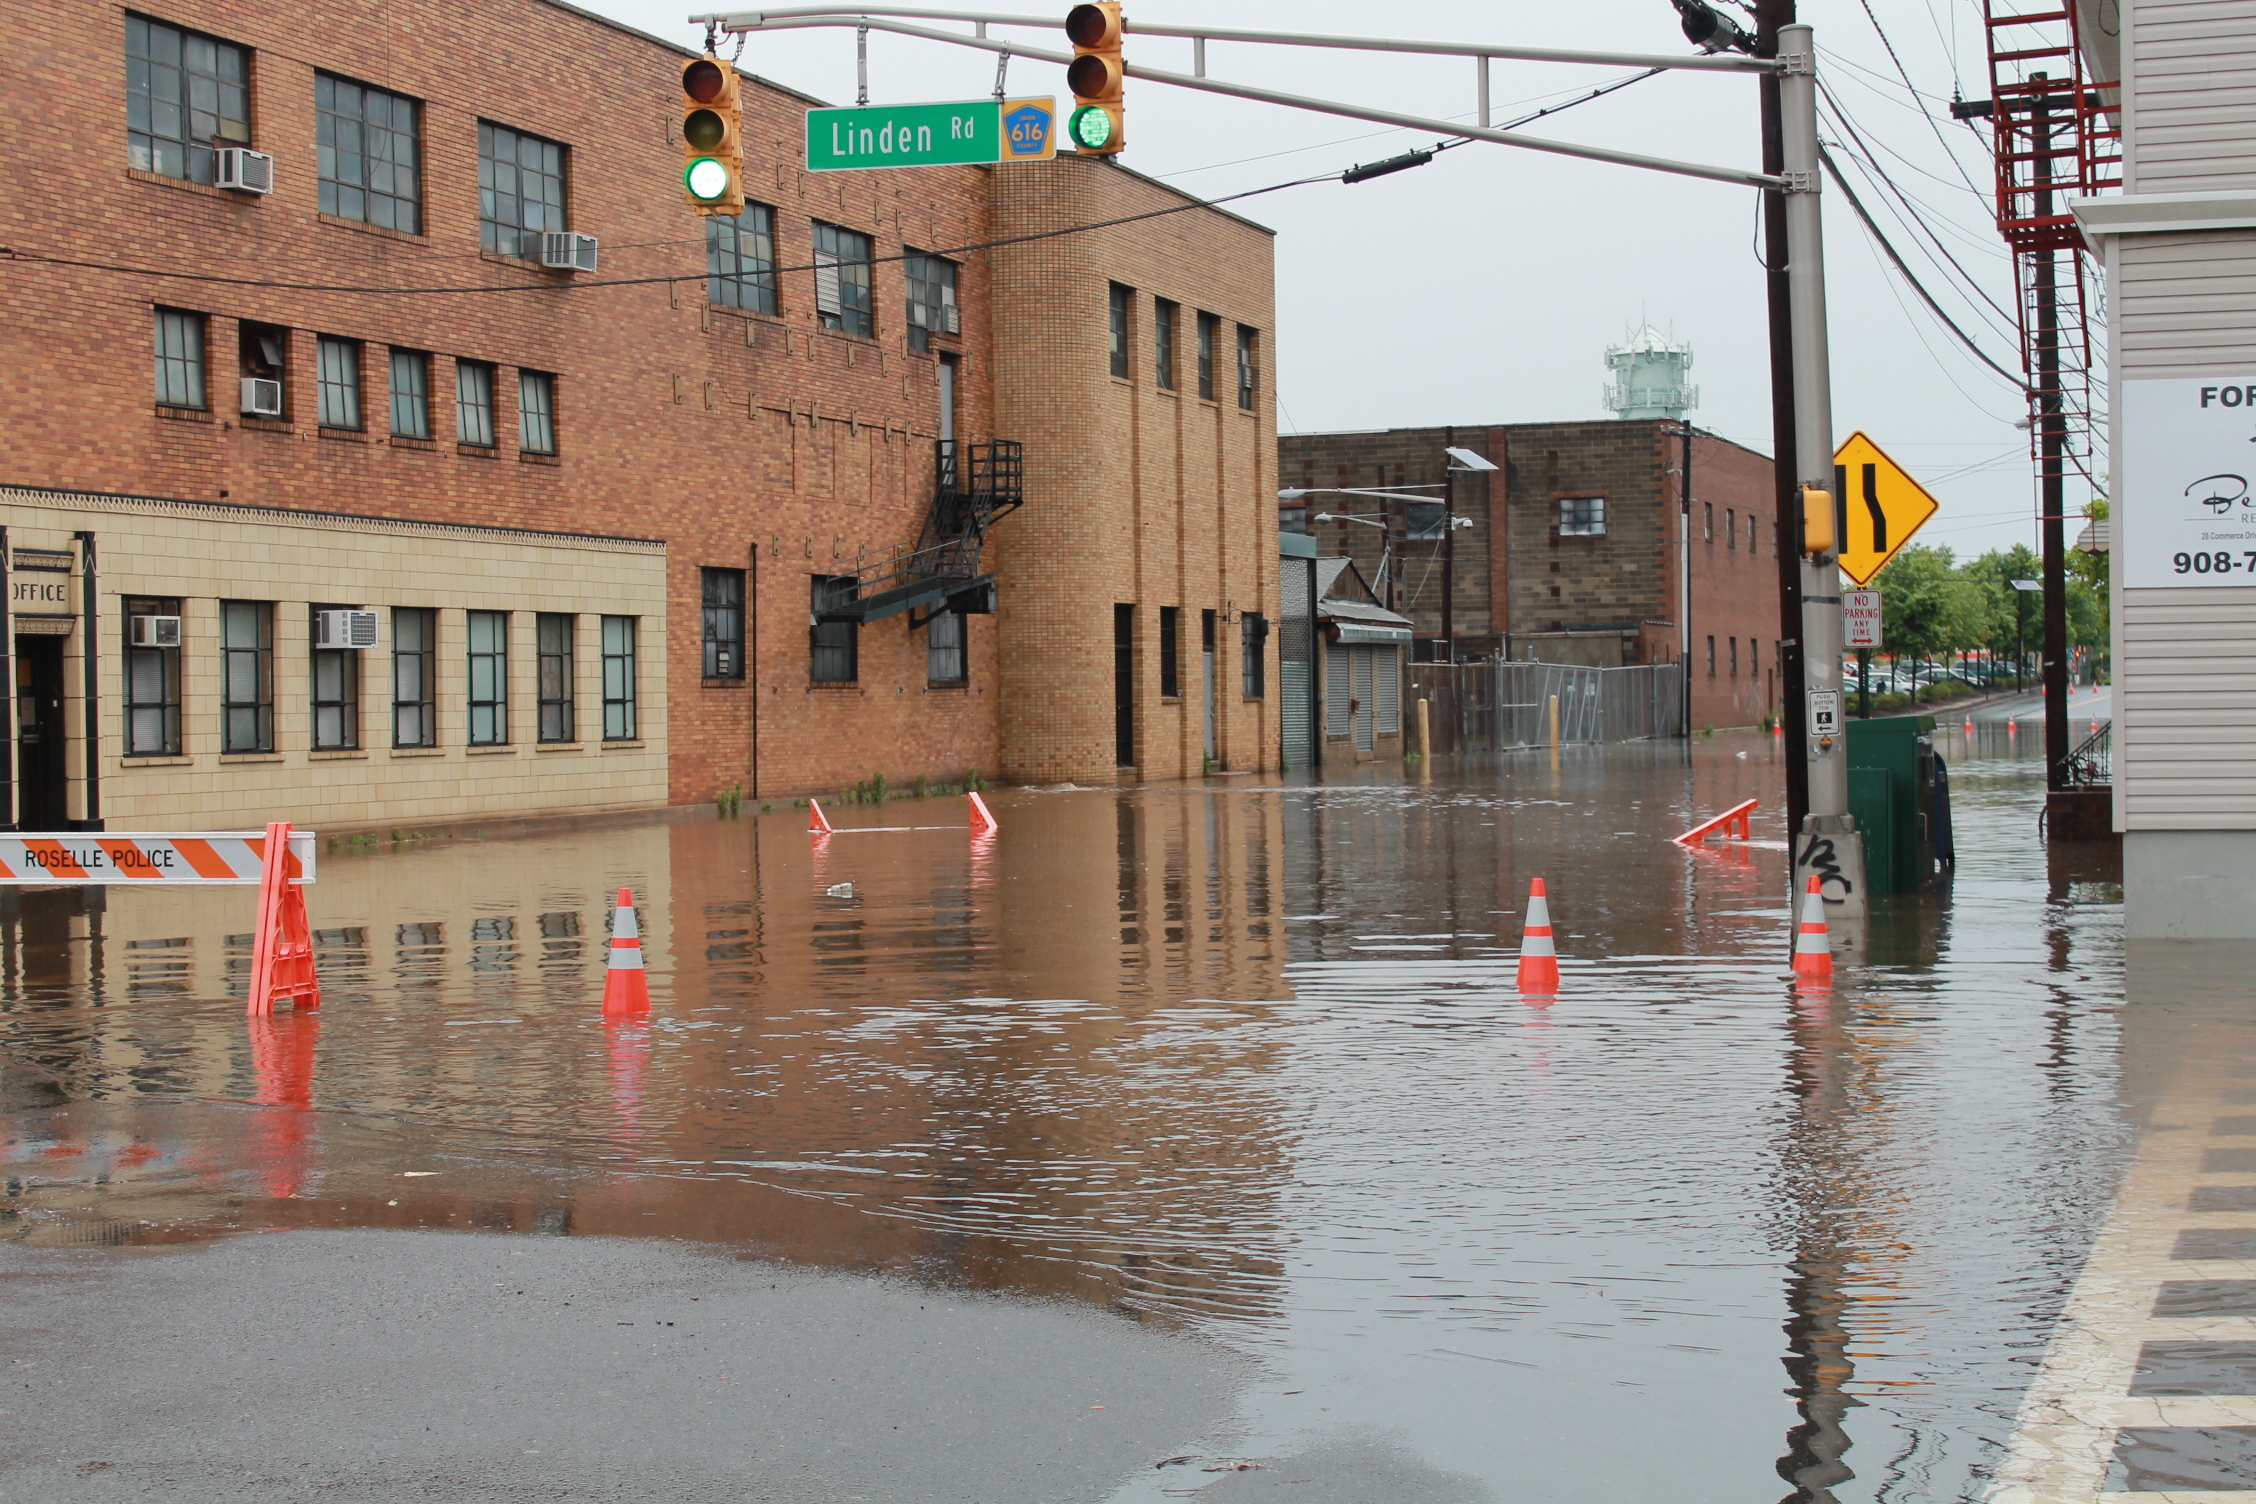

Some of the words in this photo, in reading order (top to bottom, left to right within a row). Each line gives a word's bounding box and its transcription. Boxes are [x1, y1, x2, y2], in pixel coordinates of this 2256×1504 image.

[832, 120, 931, 156] Linden
[951, 116, 974, 139] Rd
[1011, 122, 1043, 142] 616
[2201, 532, 2209, 540] 20
[2210, 532, 2244, 540] Commerce
[2173, 551, 2256, 574] 908-7
[1854, 595, 1869, 607] NO
[1844, 608, 1879, 619] PARKING
[1853, 620, 1869, 628] ANY
[1852, 628, 1871, 636] TIME
[25, 849, 104, 868] ROSELLE
[112, 849, 174, 868] POLICE
